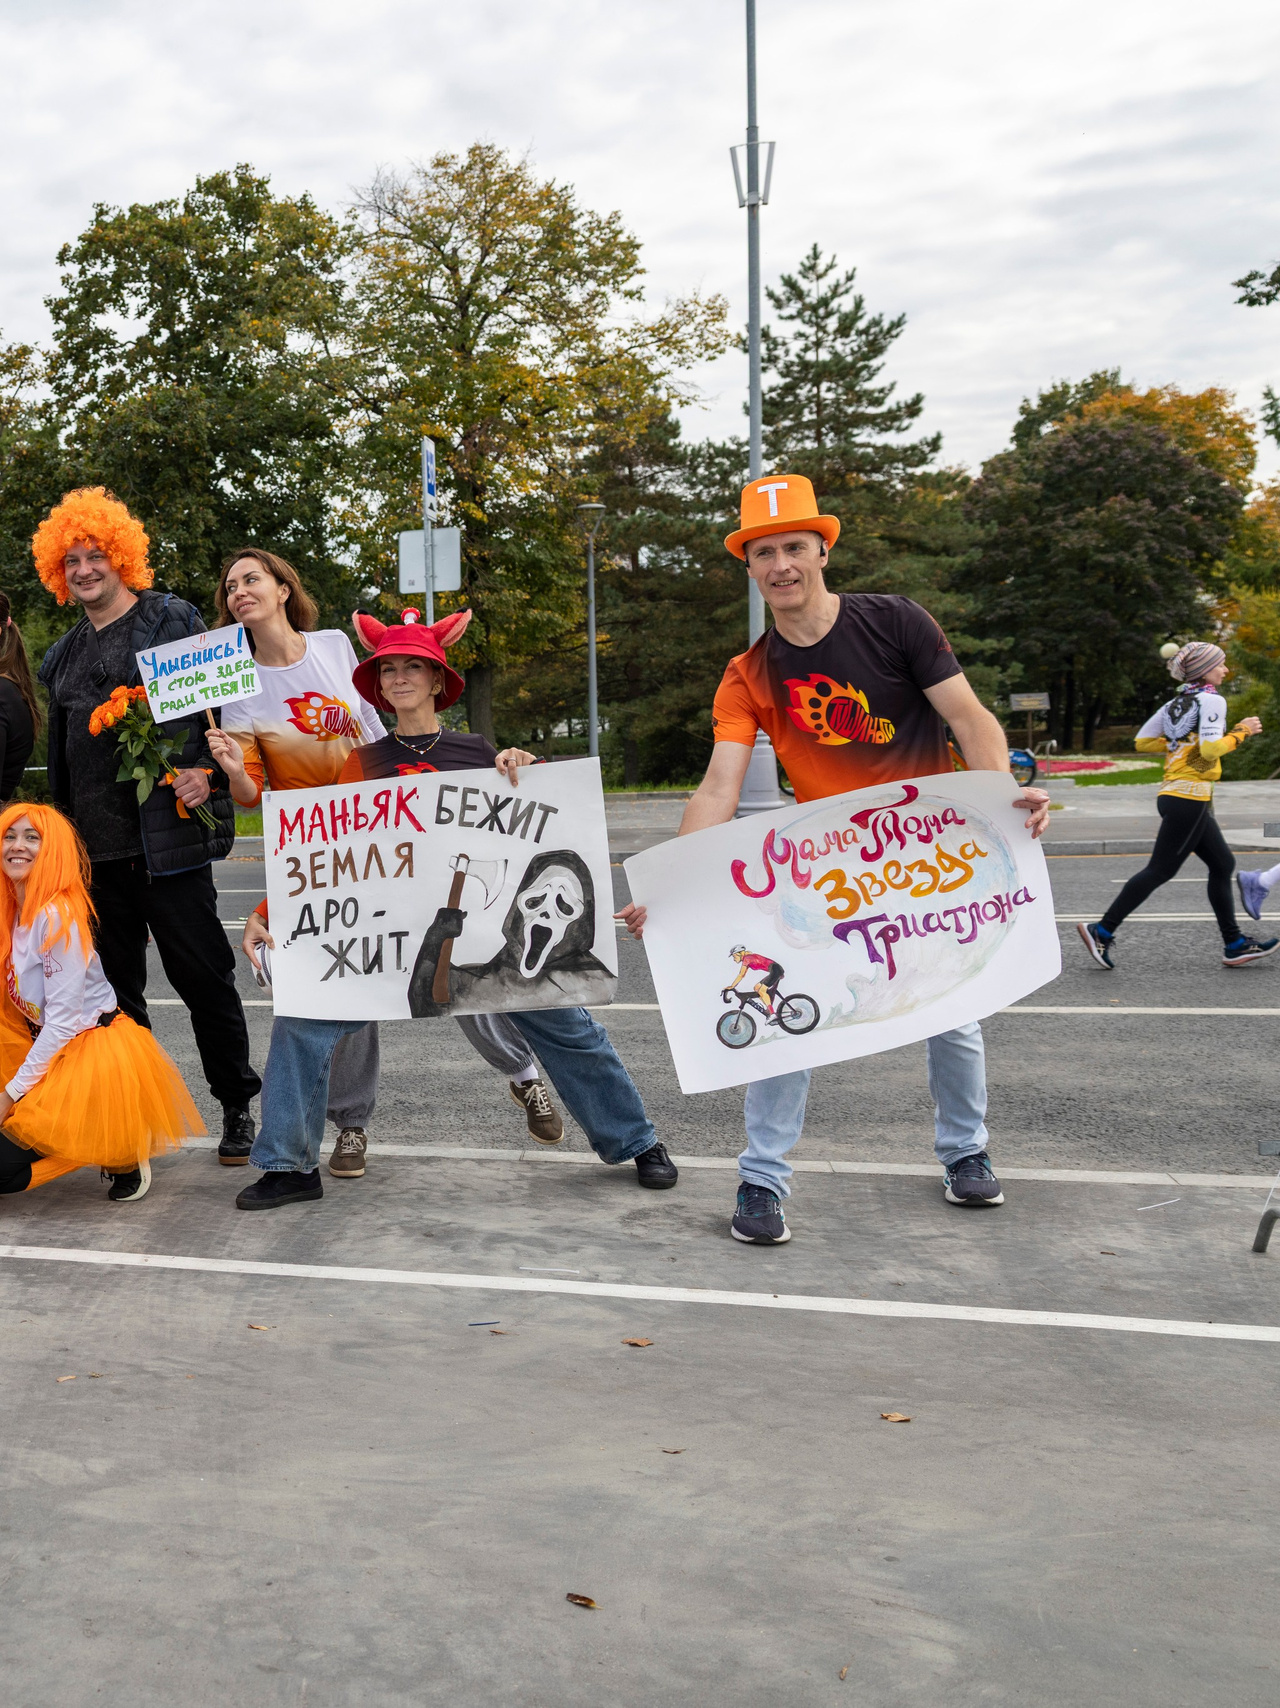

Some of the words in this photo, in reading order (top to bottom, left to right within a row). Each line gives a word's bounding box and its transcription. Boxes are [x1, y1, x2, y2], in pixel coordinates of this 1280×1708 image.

[148, 680, 160, 698] Я
[168, 671, 207, 691] СТОЮ
[216, 658, 255, 679] ЗДЕСЬ
[160, 693, 197, 714] РАДИ
[275, 785, 426, 856] МАНЬЯК
[434, 784, 559, 844] БЕЖИТ
[286, 842, 414, 898] ЗЕМЛЯ
[731, 828, 862, 898] Мама
[813, 839, 989, 919] Звезда
[833, 886, 1037, 980] Триатлона
